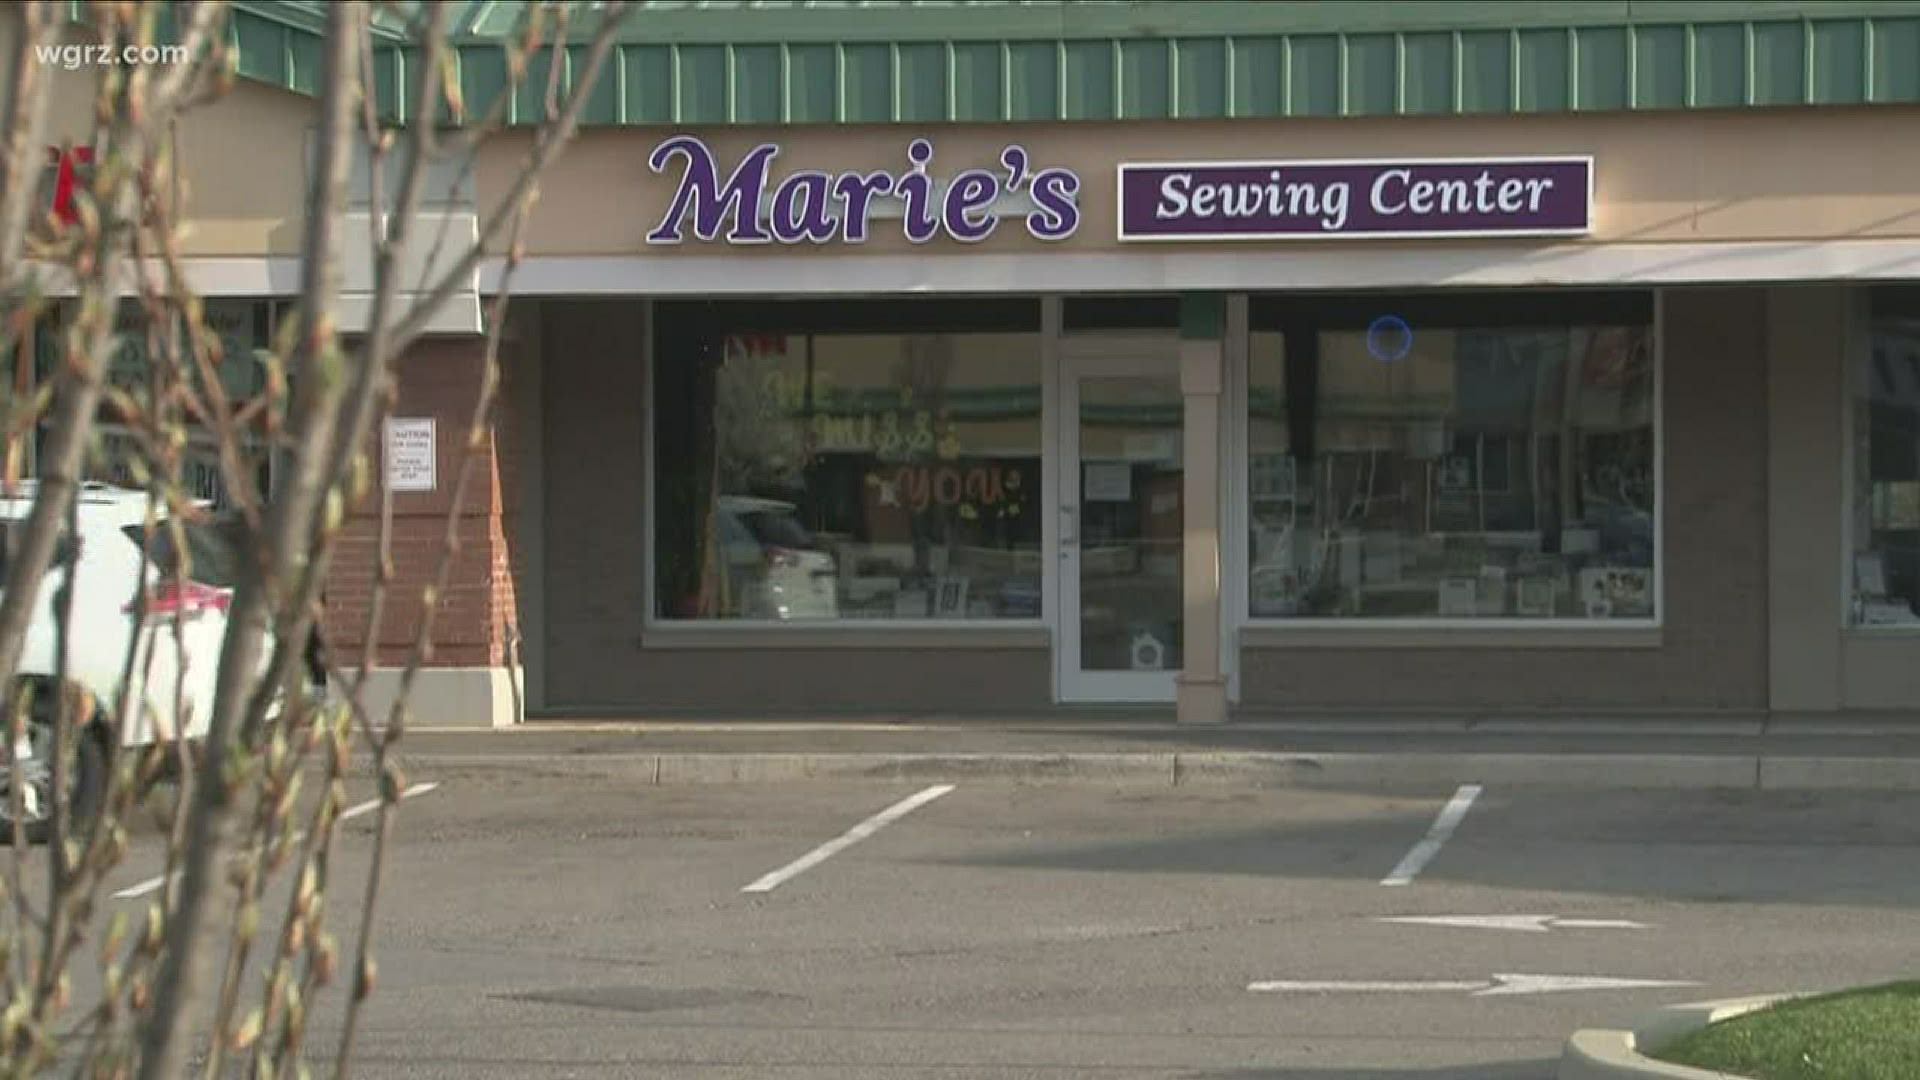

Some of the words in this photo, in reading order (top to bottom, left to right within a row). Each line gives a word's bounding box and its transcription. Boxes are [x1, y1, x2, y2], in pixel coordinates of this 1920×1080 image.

[646, 135, 1080, 243] Marie's
[1156, 170, 1349, 229] Sewing
[1370, 169, 1553, 215] Center
